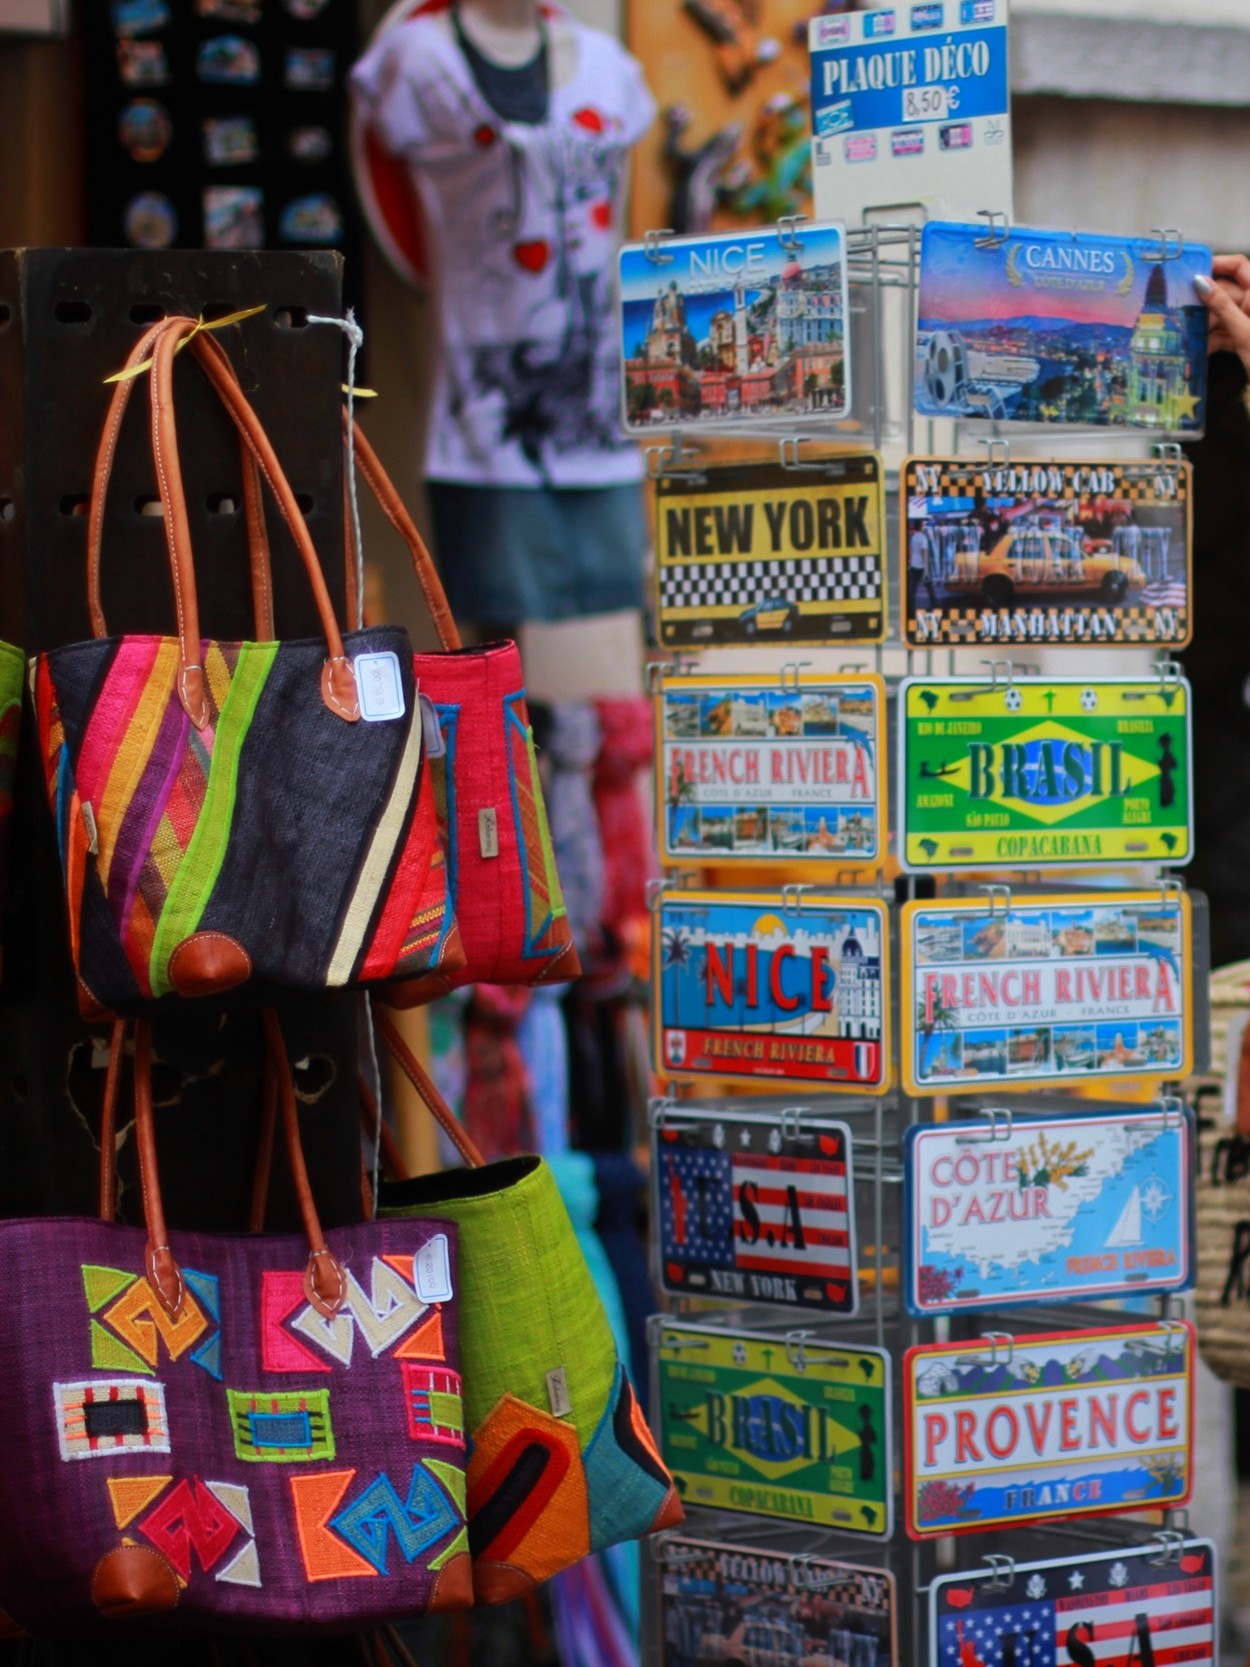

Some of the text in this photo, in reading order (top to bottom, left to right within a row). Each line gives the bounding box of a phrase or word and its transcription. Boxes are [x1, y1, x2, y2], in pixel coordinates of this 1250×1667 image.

[823, 36, 990, 95] PLAQUE DÉCO
[689, 243, 766, 279] NICE
[1026, 245, 1115, 273] CANNES
[916, 466, 942, 493] NY
[983, 469, 1115, 493] YELLOW CAB
[666, 496, 871, 557] NEW YORK
[917, 612, 942, 639] NY
[980, 612, 1117, 638] MANHATTAN
[1155, 611, 1178, 638] NY
[670, 744, 872, 798] FRENCH RIVIERA
[967, 741, 1132, 799] BRASIL
[997, 835, 1102, 858] COPACABANA
[704, 942, 833, 1012] NICE
[923, 960, 1175, 1024] FRENCH RIVIERA
[1007, 1008, 1057, 1020] D'AZUR
[1081, 1005, 1130, 1016] FRANCE
[703, 1038, 835, 1064] FRENCH RIVIERA
[930, 1147, 1053, 1228] CÔTE D'AZUR
[710, 1269, 798, 1301] NEW YORK
[705, 1388, 838, 1464] BRASIL
[923, 1387, 1179, 1467] PROVENCE
[1004, 1479, 1103, 1510] FRANCE
